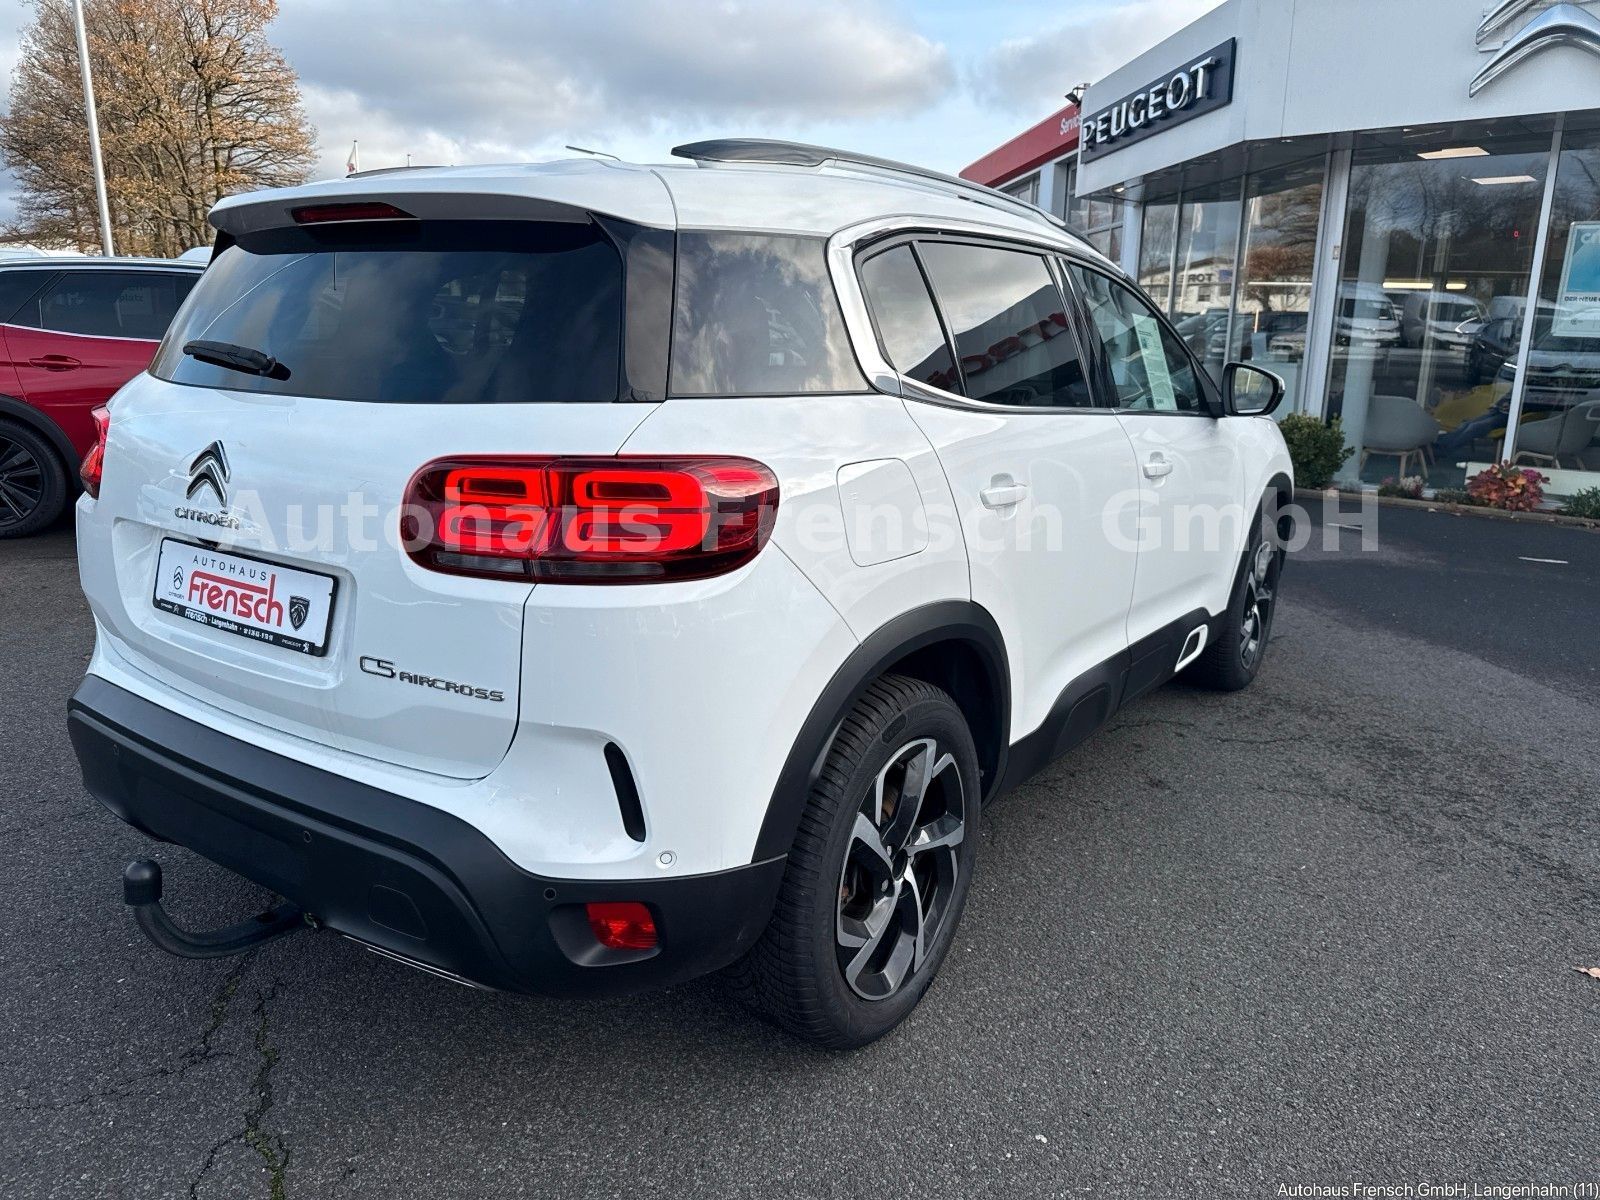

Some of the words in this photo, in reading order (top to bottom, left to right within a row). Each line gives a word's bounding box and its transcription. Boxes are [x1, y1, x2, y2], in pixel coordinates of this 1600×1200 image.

[1082, 56, 1216, 152] PEUGEOT
[192, 554, 268, 582] AUTOHAUS
[188, 570, 284, 627] Frensch
[399, 671, 505, 702] AIRCROSS
